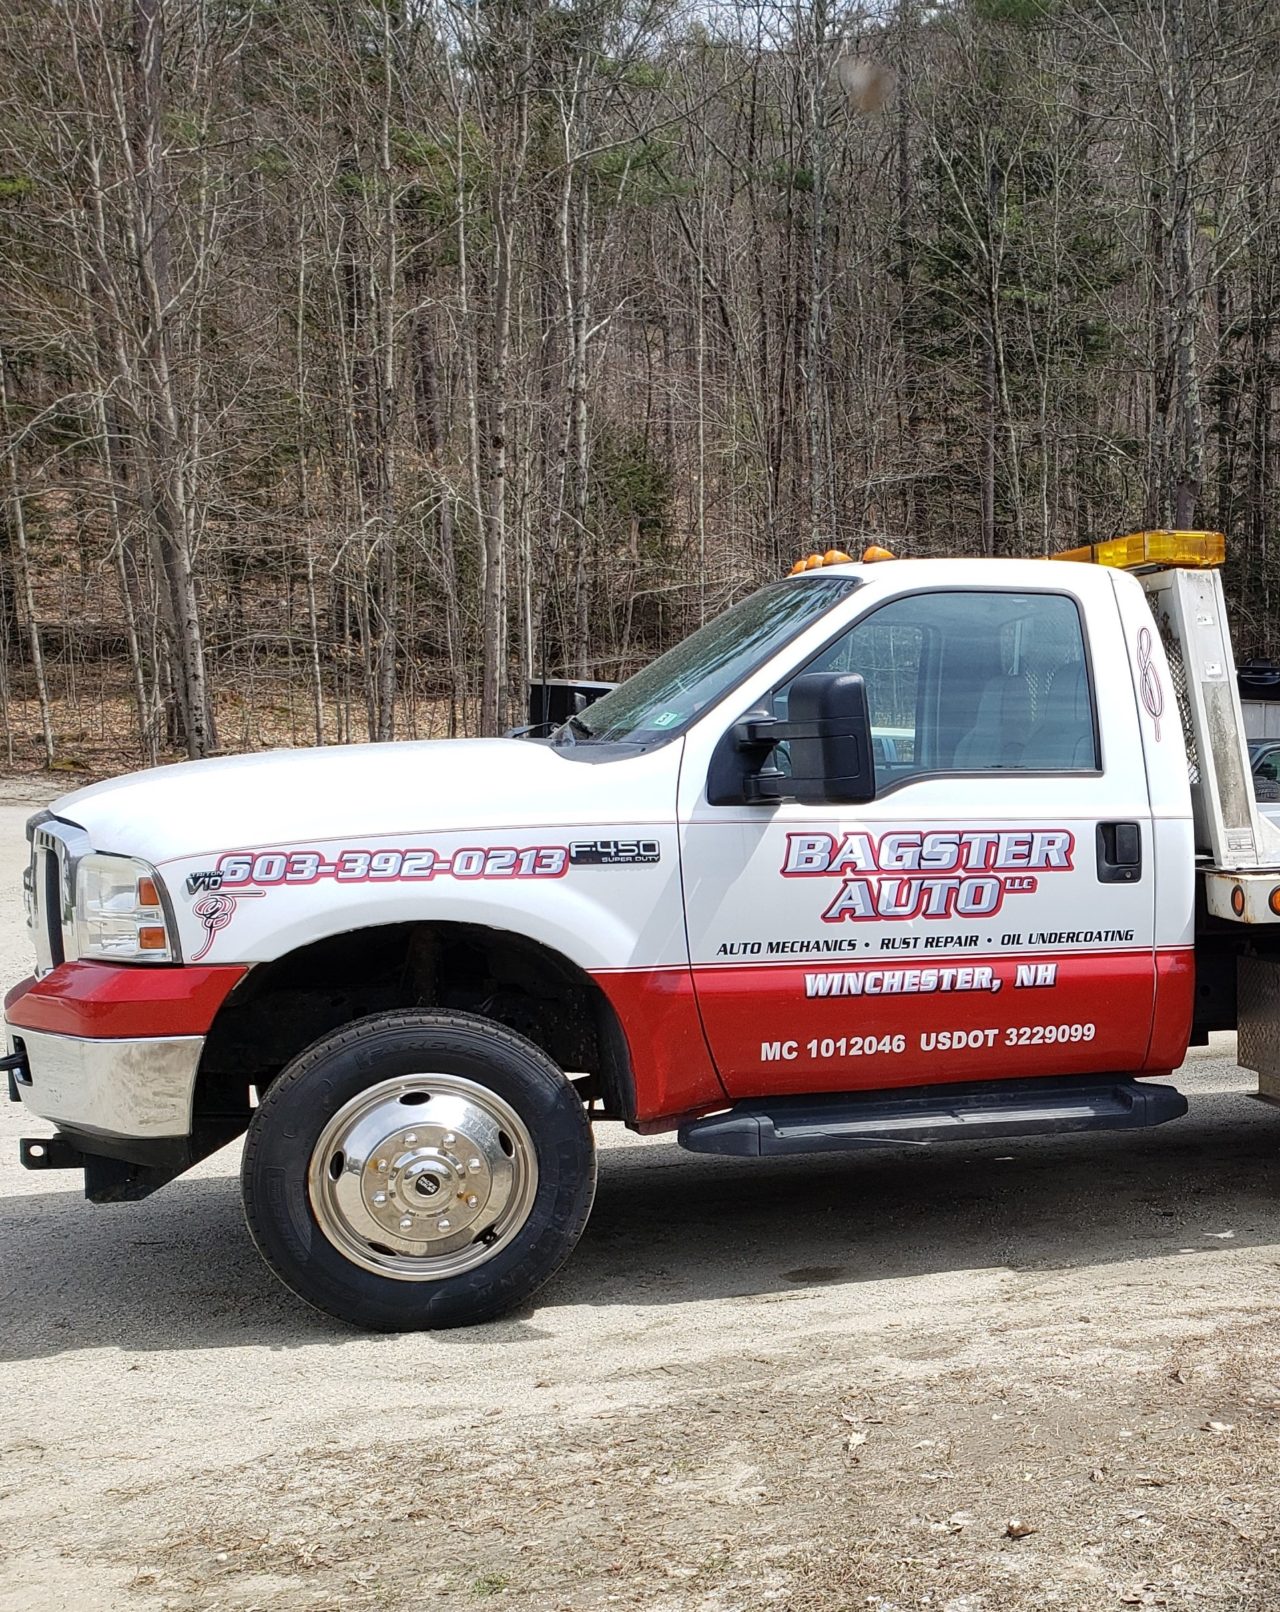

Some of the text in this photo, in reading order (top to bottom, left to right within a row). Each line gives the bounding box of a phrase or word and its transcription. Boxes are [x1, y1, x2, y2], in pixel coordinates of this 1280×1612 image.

[217, 848, 568, 885] 603-392-0213
[601, 854, 660, 864] SUPER DUTY
[782, 831, 1073, 876] BAGSTER
[186, 876, 223, 895] V10
[190, 870, 224, 878] TRITON
[823, 876, 1034, 920] AUTO LLC
[716, 929, 1135, 956] AUTO MECHANICS RUST REPAIR OIL UNDERCOATING
[803, 963, 1057, 998] WINCHESTER, NH
[760, 1022, 1096, 1062] MC 1012046 USDOT 3229099
